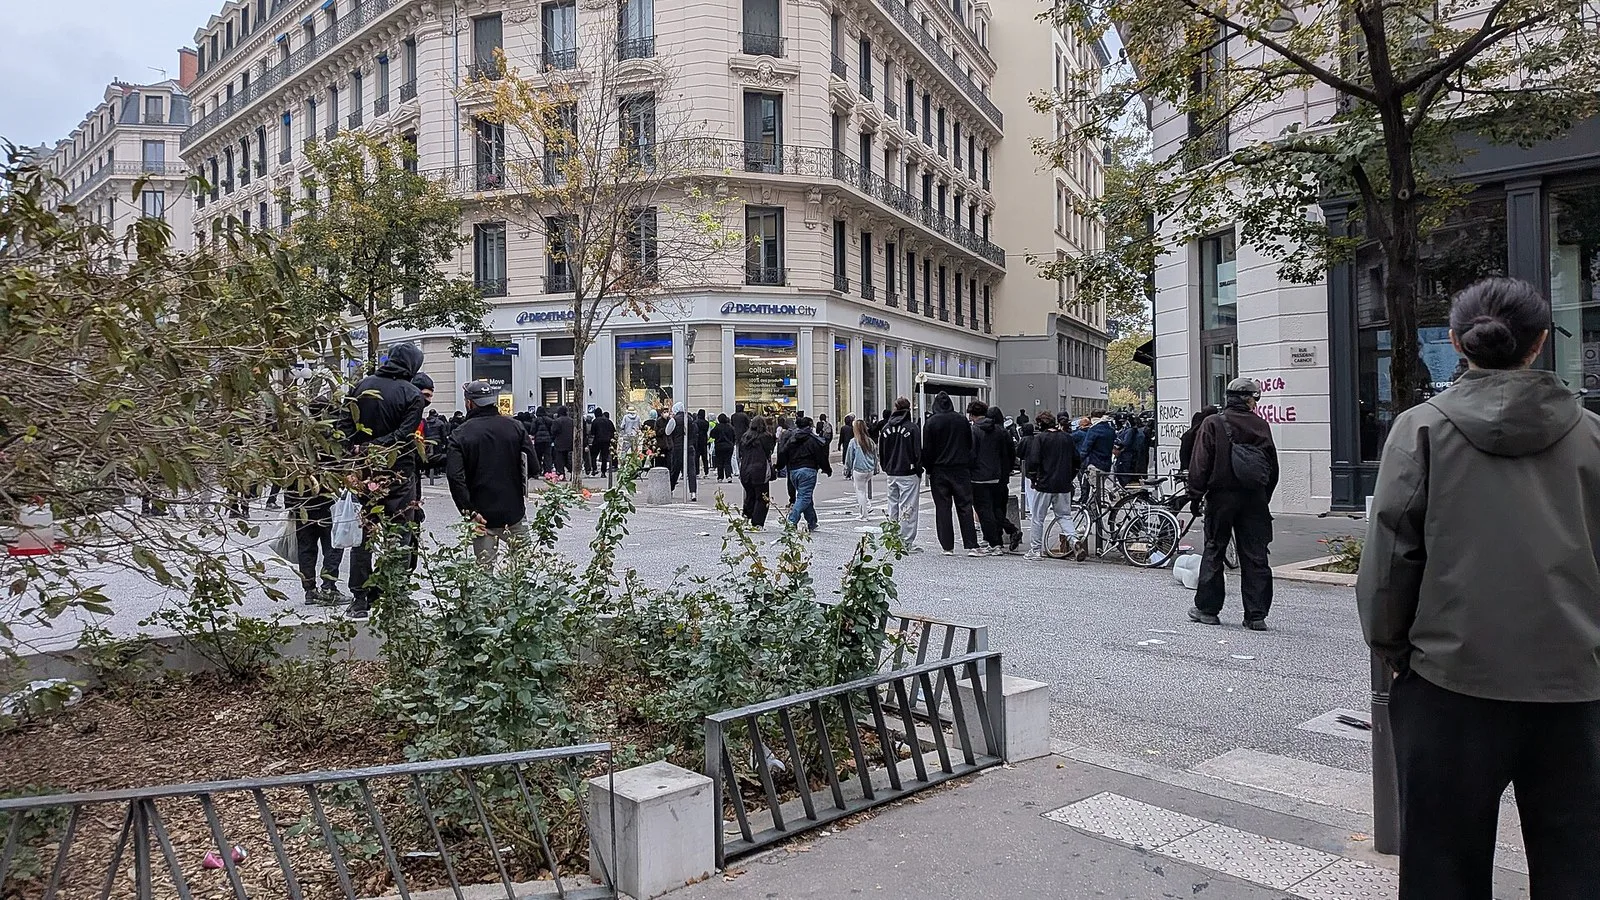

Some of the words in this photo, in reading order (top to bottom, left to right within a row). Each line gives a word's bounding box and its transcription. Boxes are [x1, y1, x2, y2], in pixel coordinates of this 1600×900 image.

[529, 310, 576, 321] DECATHLO
[736, 304, 795, 314] DECATHLON
[798, 306, 817, 317] City
[1159, 405, 1185, 420] RENDEZ
